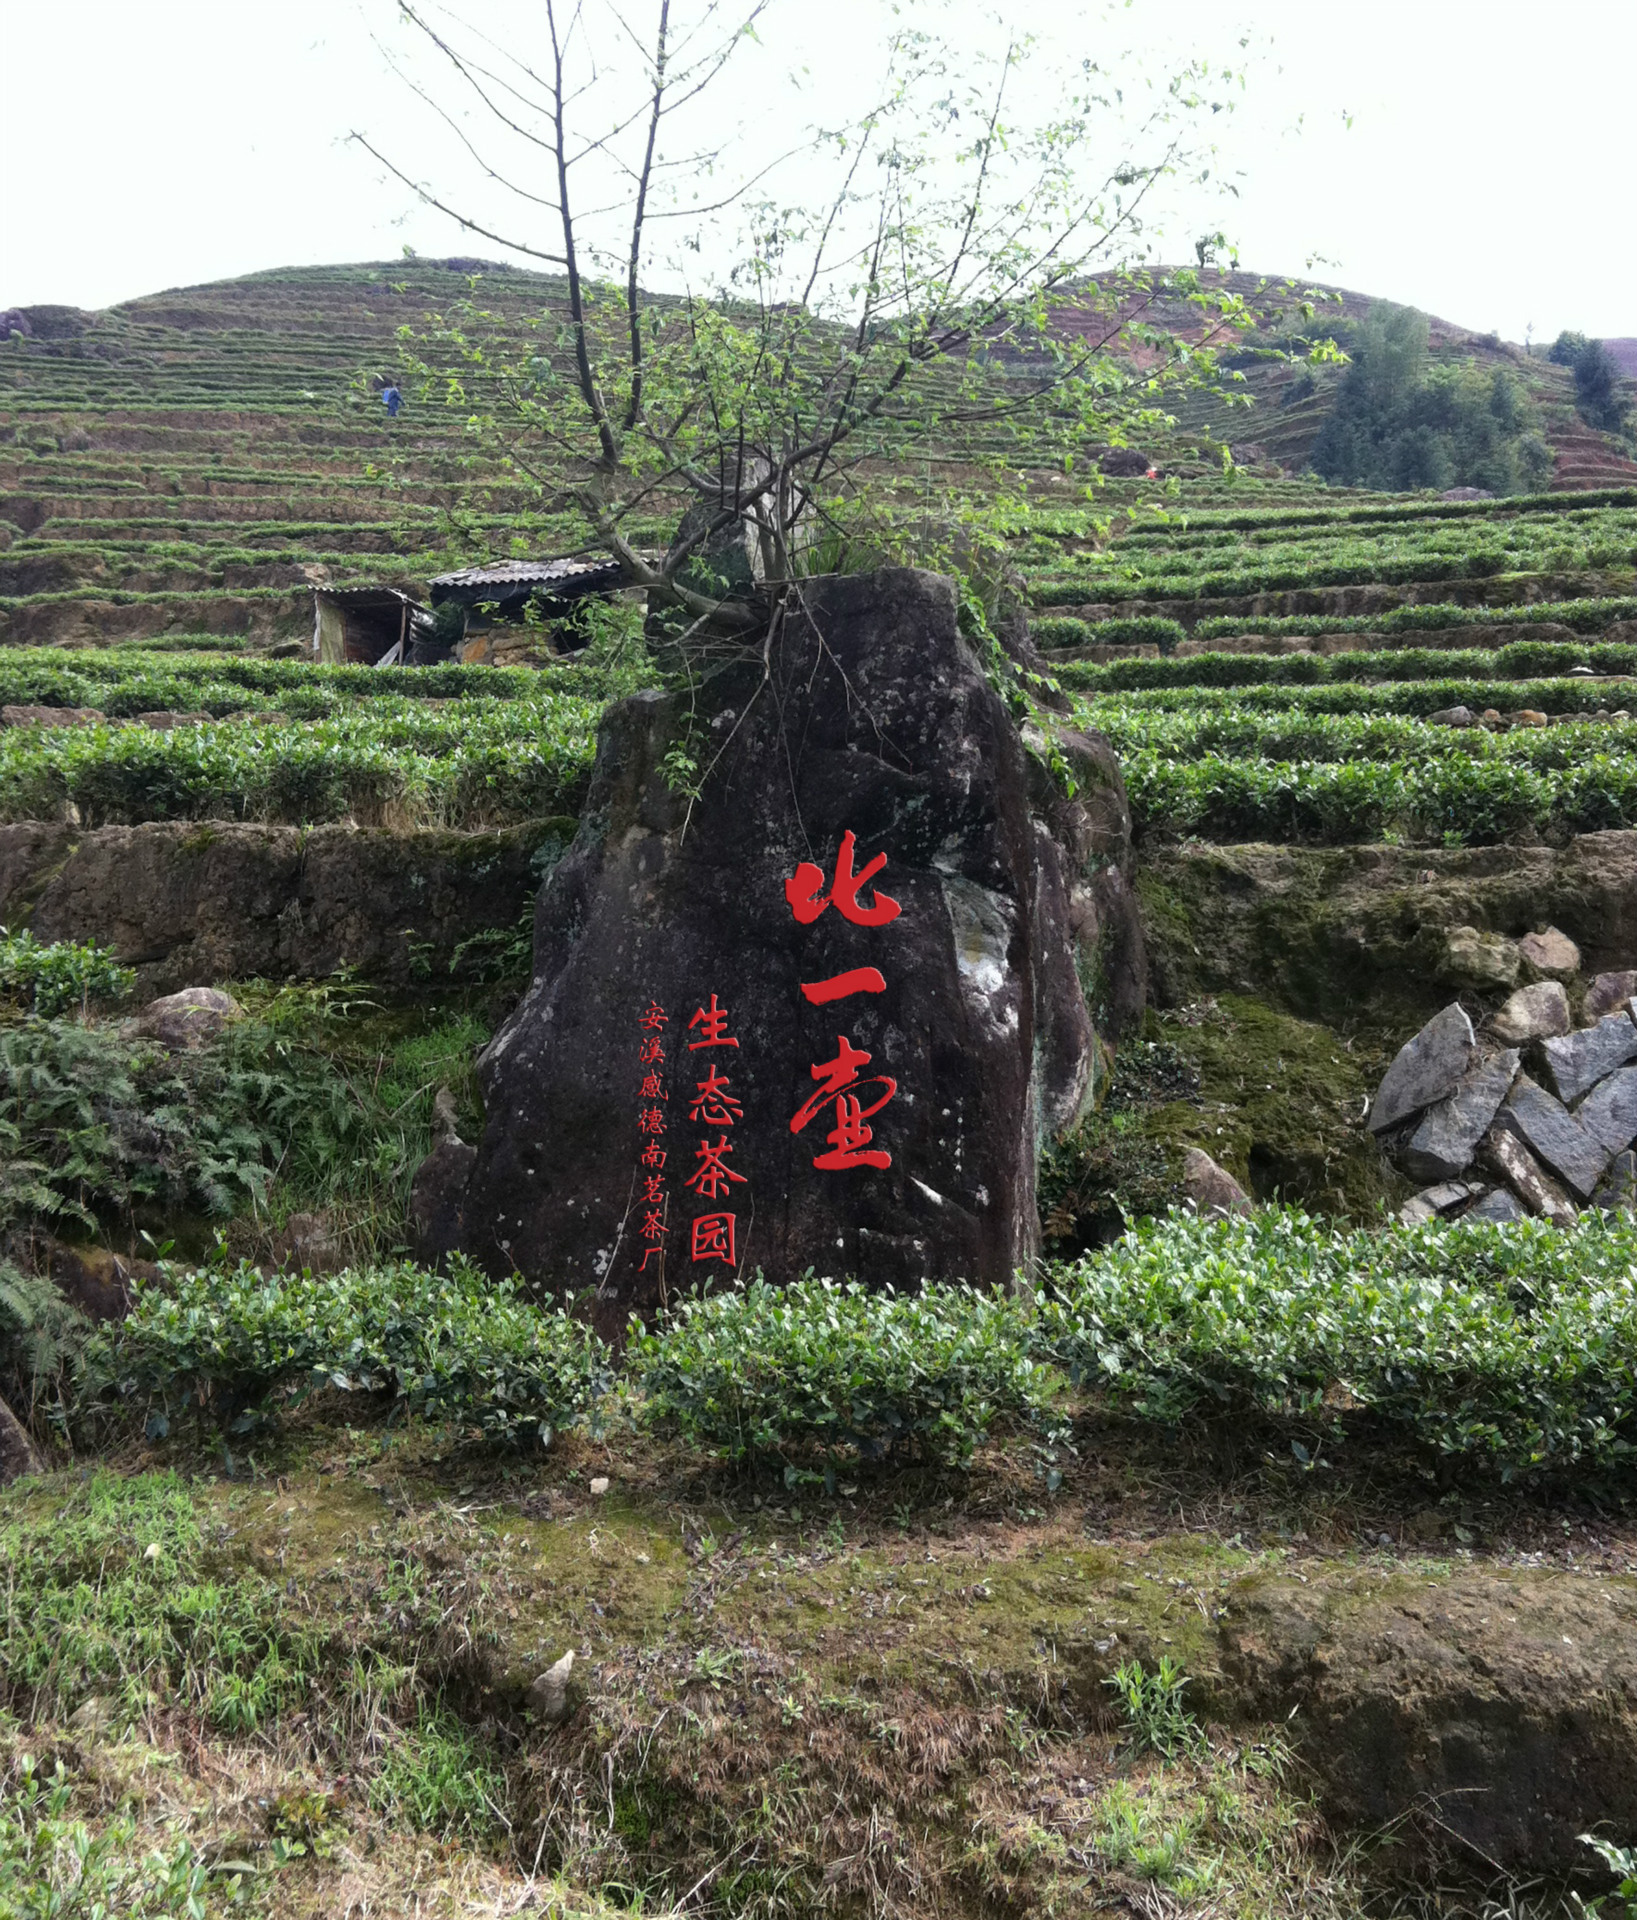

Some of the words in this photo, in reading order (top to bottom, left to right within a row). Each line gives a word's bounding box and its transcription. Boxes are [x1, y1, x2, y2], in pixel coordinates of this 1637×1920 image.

[637, 1000, 670, 1273] 安溪感德南茗茶厂
[683, 993, 748, 1268] 生态茶园
